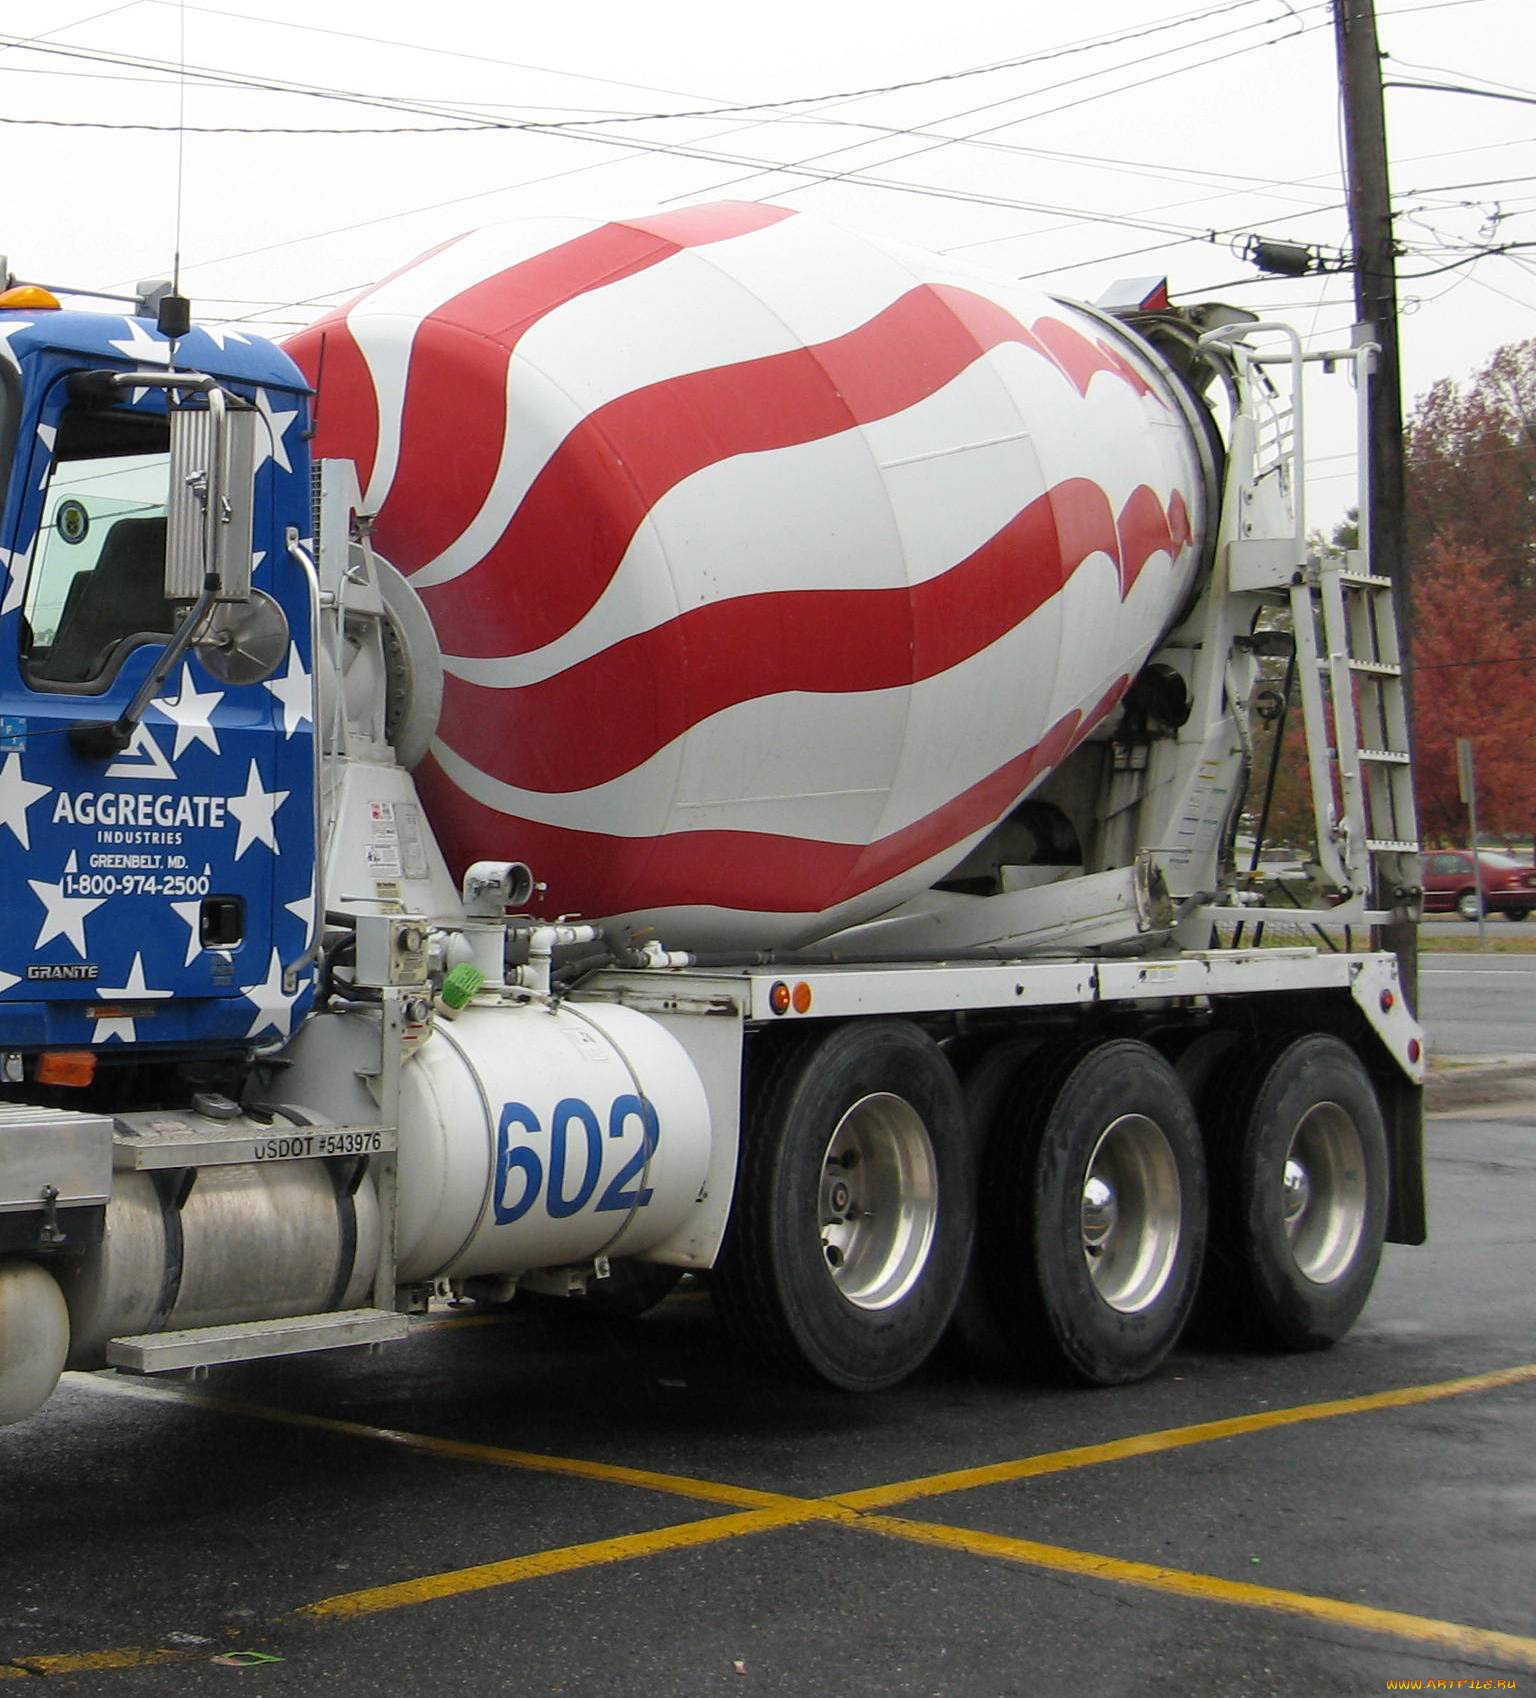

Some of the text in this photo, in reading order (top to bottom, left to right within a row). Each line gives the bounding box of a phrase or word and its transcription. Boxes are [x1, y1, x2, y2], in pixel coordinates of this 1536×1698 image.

[52, 791, 225, 828] AGGREGATE
[97, 831, 183, 845] INDUSTRIES
[66, 874, 210, 896] 1-800-974-2500
[27, 965, 99, 979] GRANITE
[255, 1132, 381, 1160] USDOT #543976
[494, 1094, 660, 1226] 602
